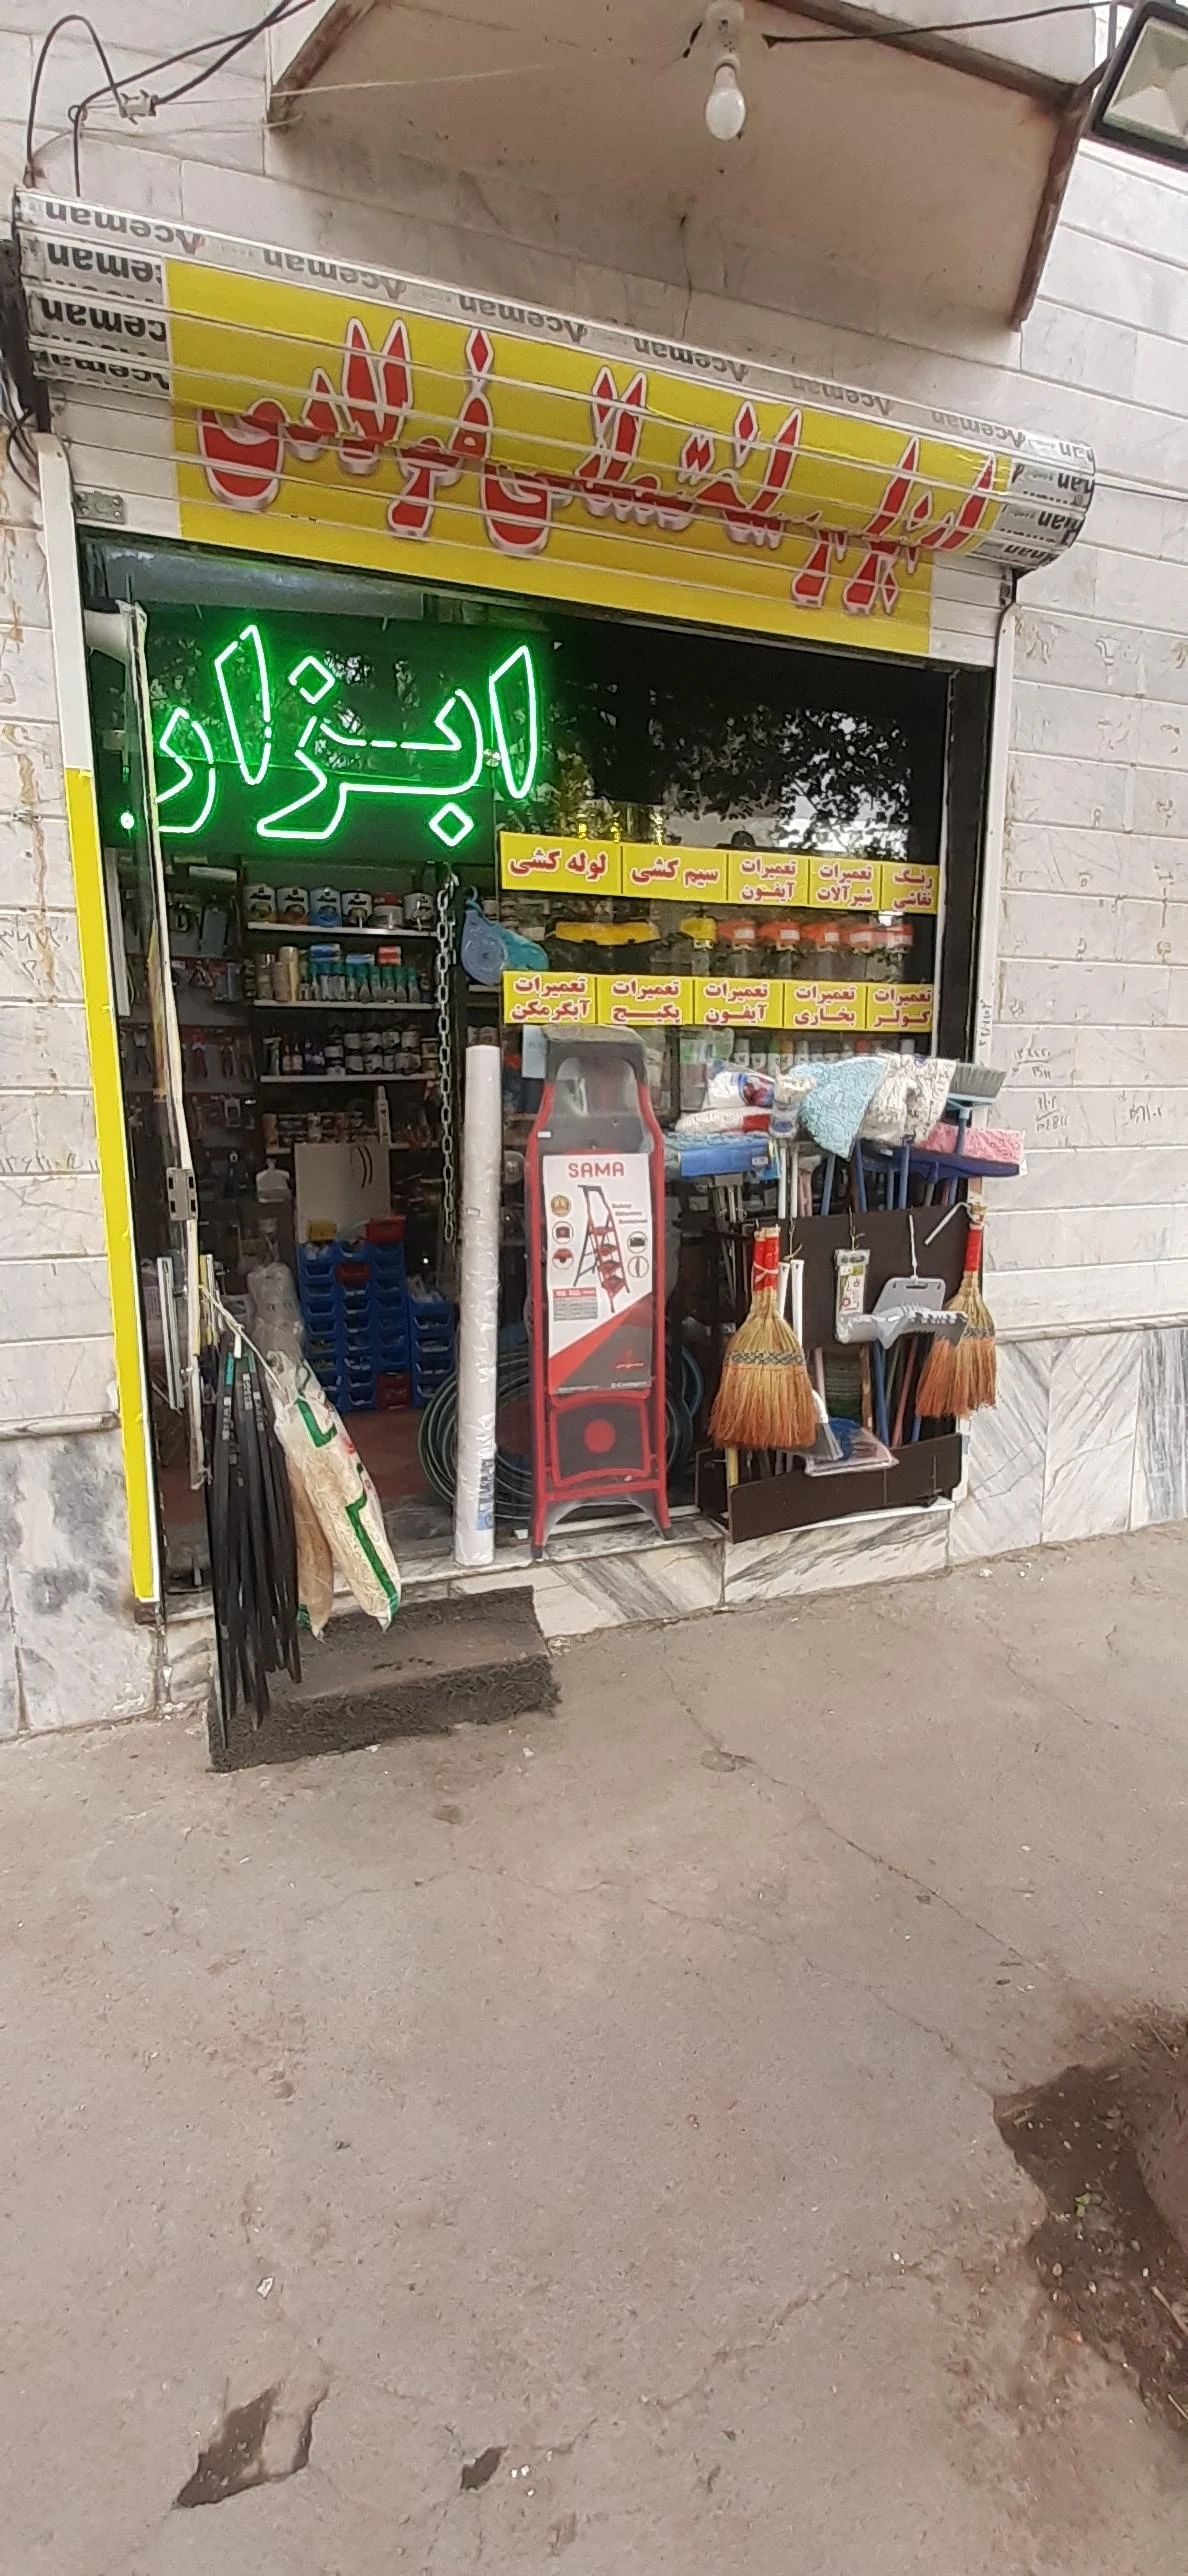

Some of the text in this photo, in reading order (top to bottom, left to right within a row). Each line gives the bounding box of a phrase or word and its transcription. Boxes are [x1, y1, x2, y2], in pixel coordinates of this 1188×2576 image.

[45, 200, 206, 256] Aceman
[262, 246, 407, 301] Aceman
[455, 291, 588, 344] Aceman
[633, 336, 750, 383] Aceman
[790, 374, 896, 417] Aceman
[930, 406, 1027, 450] Aceman
[483, 365, 803, 555] ساختمانی
[792, 436, 998, 614] ابزار
[122, 623, 539, 848] ابزار
[510, 849, 607, 881] لوله کشی
[631, 858, 719, 887] سیم کشی
[741, 857, 797, 879] تعمیرات
[819, 863, 872, 883] تعمیرات
[741, 882, 795, 902] آیفون
[893, 890, 932, 910] نقاشی
[514, 976, 587, 997] تعمیرات
[612, 978, 679, 1000] تعمیرات
[705, 983, 768, 1002] تعمیرات
[795, 985, 856, 1004] تعمیرات
[874, 987, 932, 1006] تعمیرات
[612, 1004, 680, 1024] پکیج
[705, 1004, 767, 1024] آیفون
[794, 1007, 856, 1026] بخاری
[873, 1009, 931, 1028] کولر
[567, 1161, 626, 1179] SAMA
